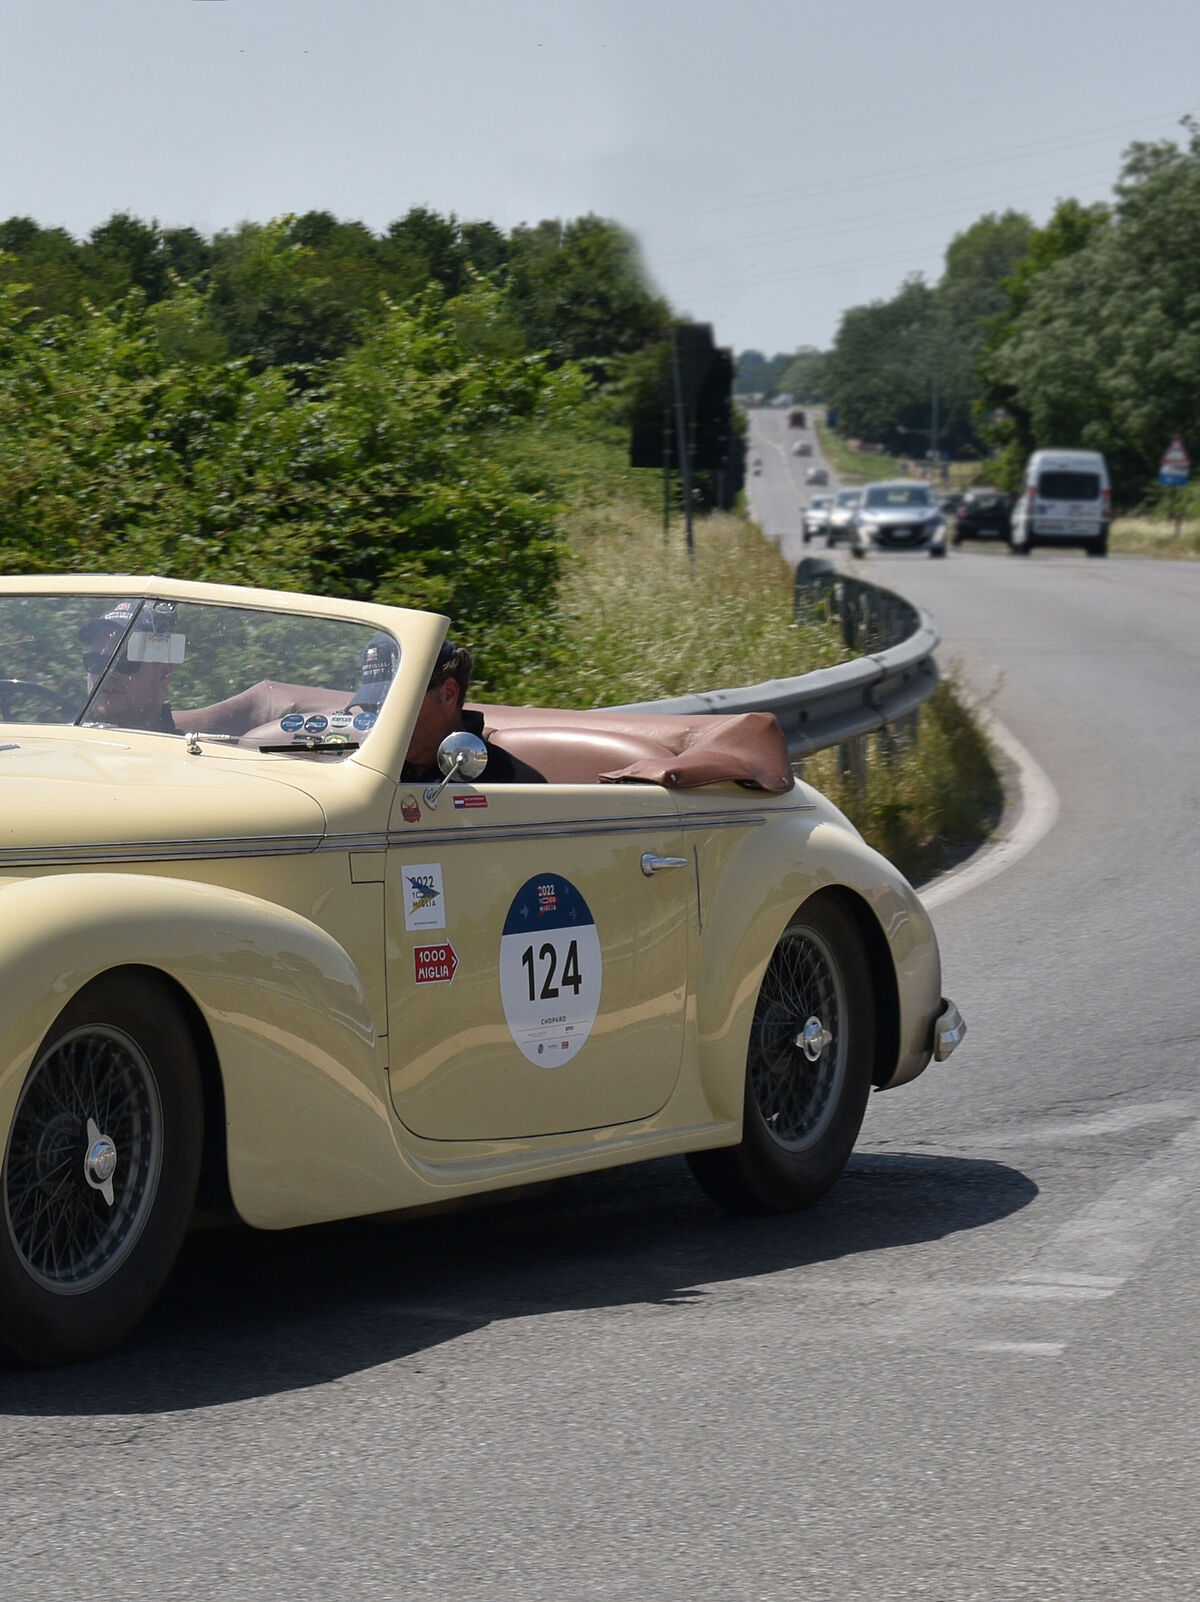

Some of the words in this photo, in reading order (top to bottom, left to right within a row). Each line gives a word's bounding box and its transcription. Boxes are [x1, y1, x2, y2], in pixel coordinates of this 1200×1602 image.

[411, 876, 434, 889] 2022
[537, 885, 555, 896] 2022
[419, 950, 446, 963] 1000
[418, 965, 449, 979] MIGLIA
[522, 940, 582, 1001] 124
[541, 1016, 567, 1025] CHOPARD
